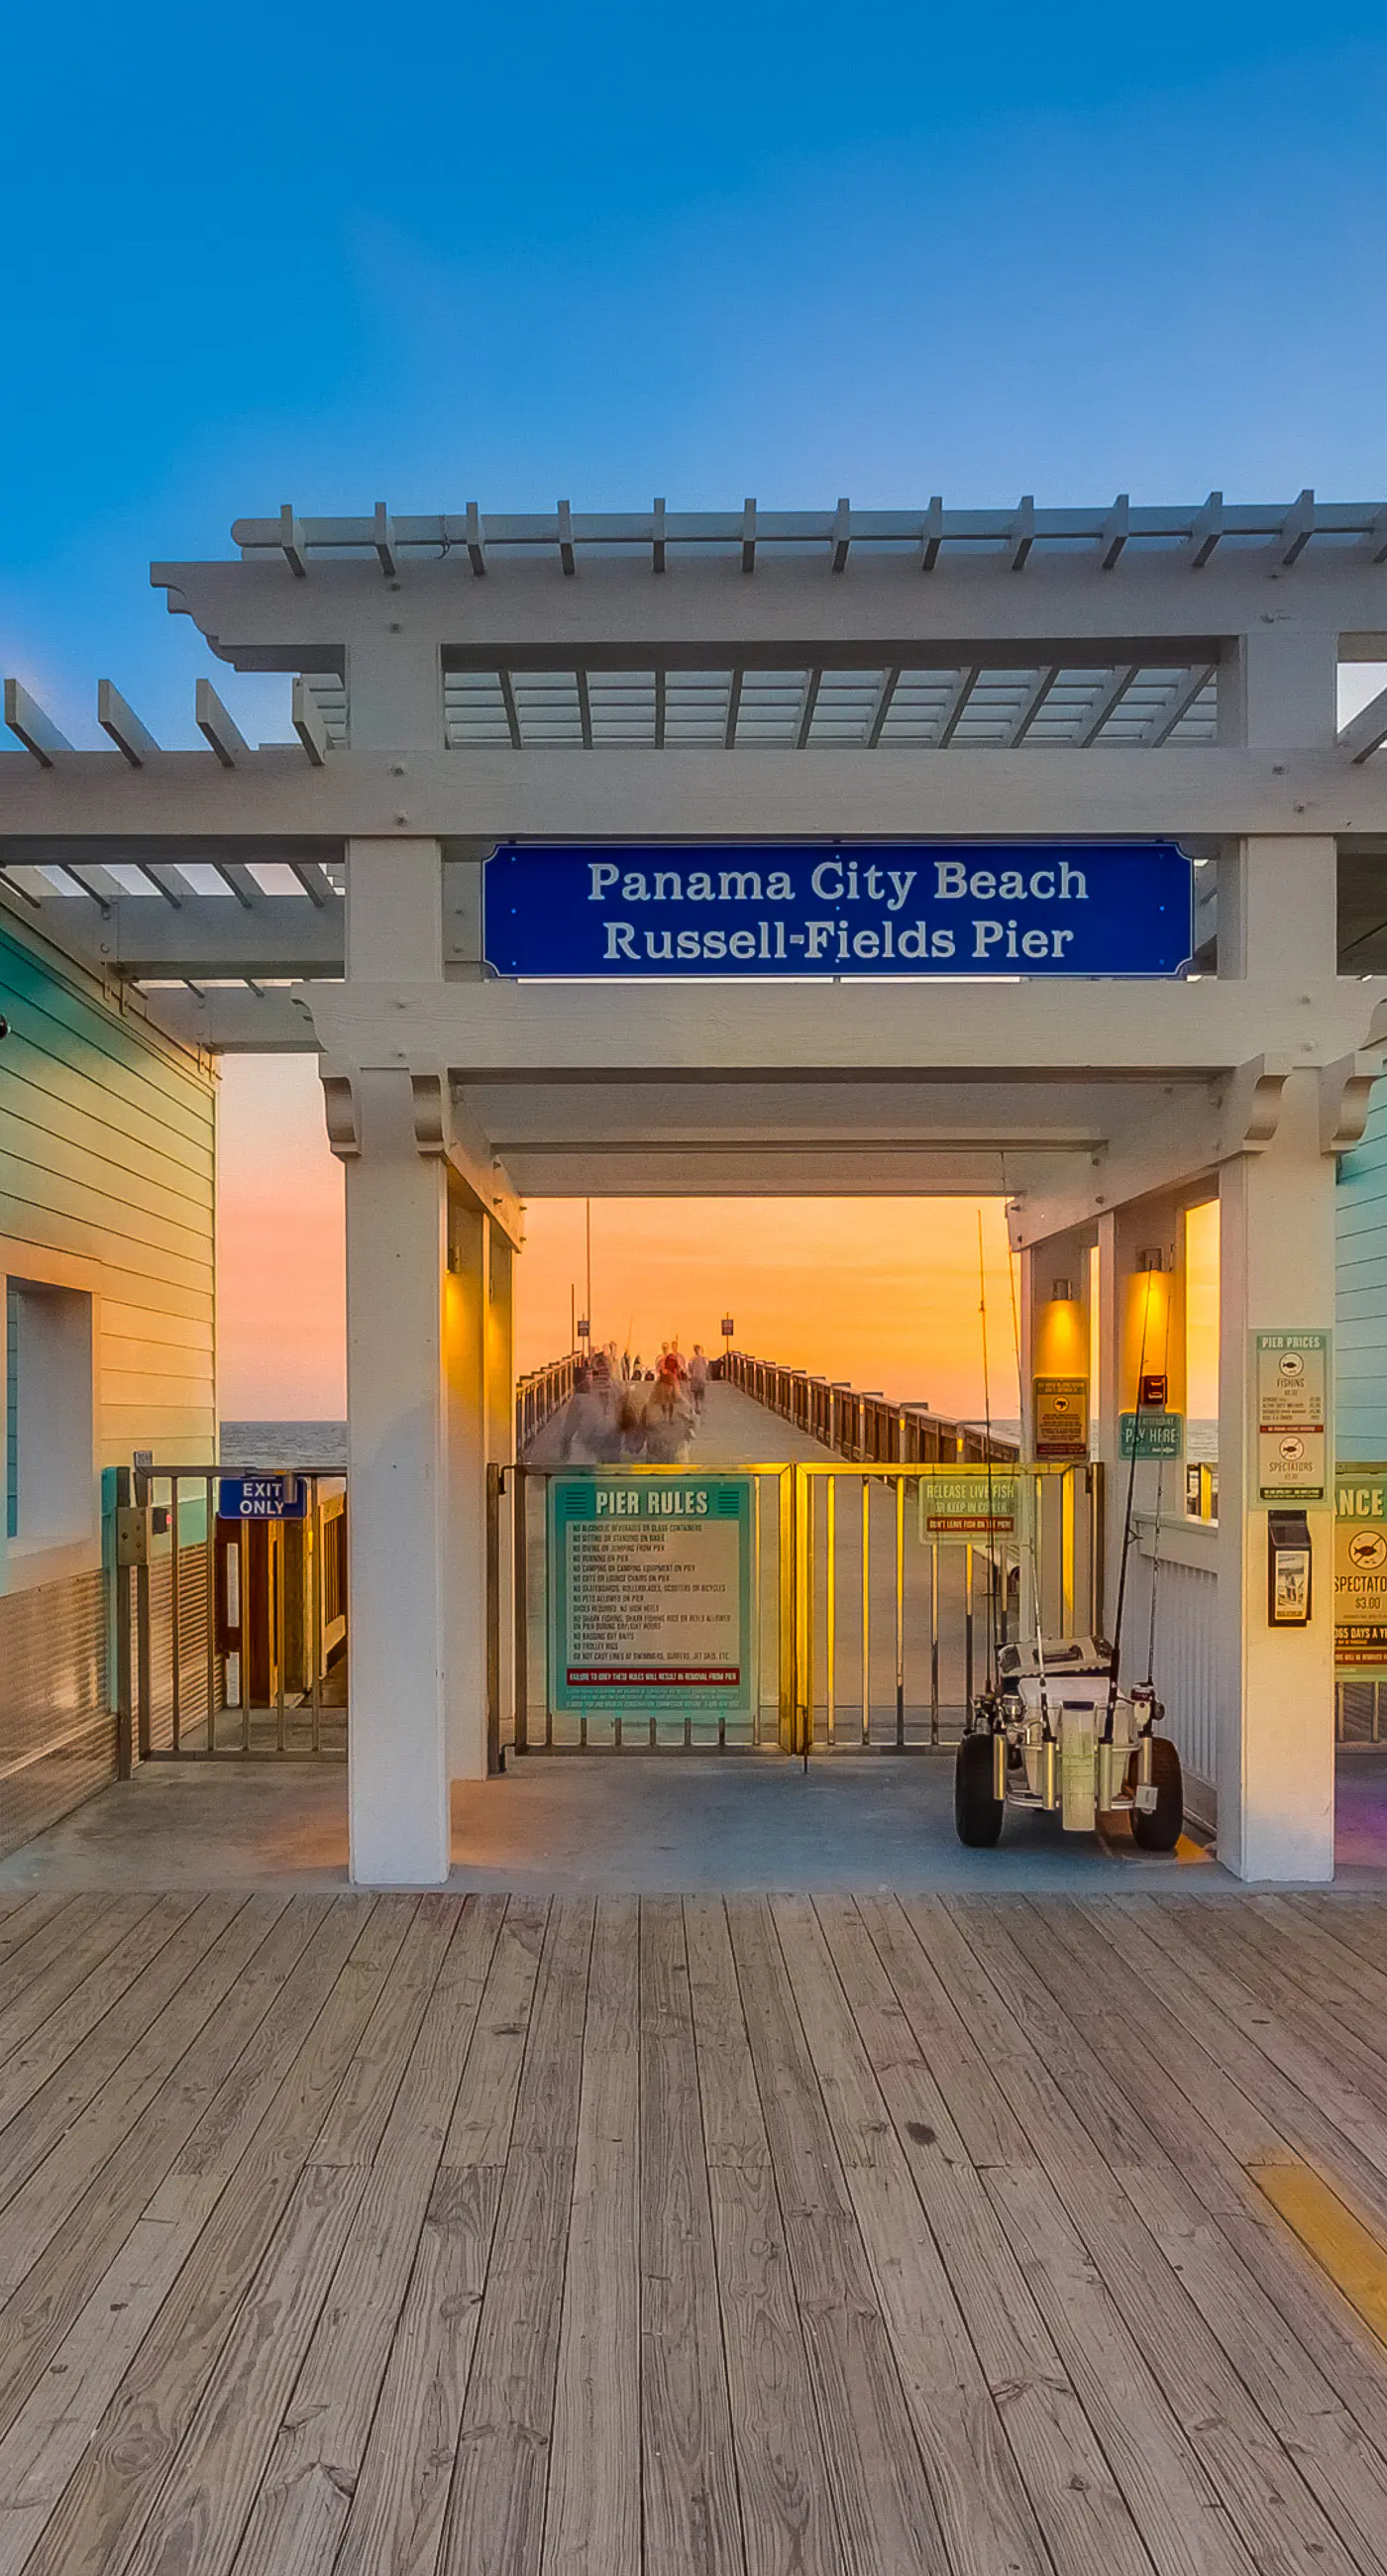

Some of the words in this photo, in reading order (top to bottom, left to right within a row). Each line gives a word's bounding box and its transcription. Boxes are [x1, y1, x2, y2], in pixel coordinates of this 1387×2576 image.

[587, 864, 796, 900] Panama
[810, 862, 915, 911] City
[933, 862, 1088, 900] Beach
[602, 921, 955, 959] Russell-Fields
[971, 921, 1075, 959] Pier
[1262, 1337, 1284, 1348] PIER
[1287, 1337, 1321, 1348] PRICES
[1277, 1378, 1305, 1388] FISHING
[1149, 1429, 1176, 1443] HERE
[1269, 1462, 1313, 1472] SPECTATORS
[243, 1483, 282, 1497] EXIT
[927, 1485, 967, 1499] RELEASE
[969, 1485, 989, 1499] LIVE
[993, 1485, 1014, 1499] FISH
[240, 1501, 284, 1514] ONLY
[596, 1491, 639, 1515] PIER
[648, 1491, 708, 1515] RULES
[978, 1502, 1007, 1513] COLER
[1355, 1597, 1381, 1609] $3.00
[1351, 1627, 1370, 1639] DAYS
[1372, 1627, 1378, 1639] A
